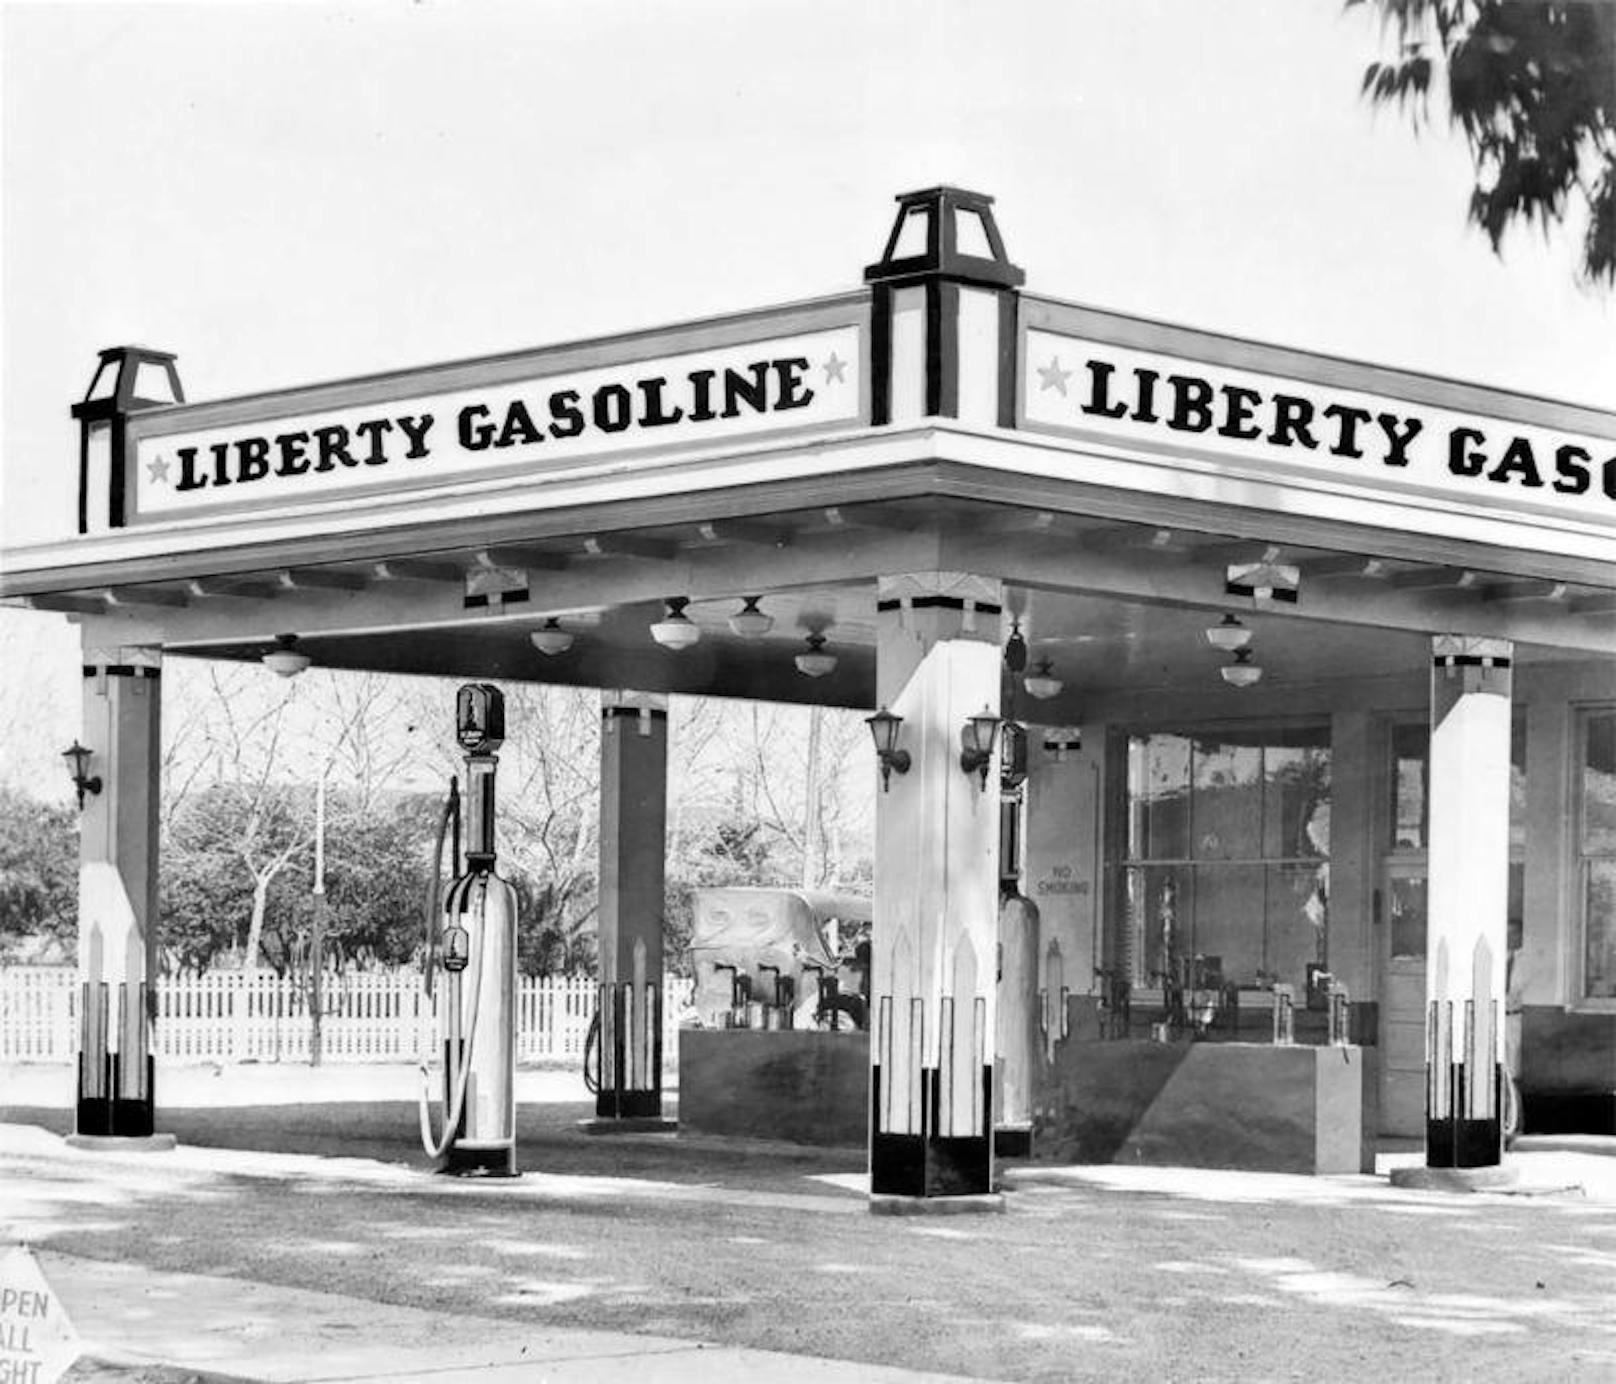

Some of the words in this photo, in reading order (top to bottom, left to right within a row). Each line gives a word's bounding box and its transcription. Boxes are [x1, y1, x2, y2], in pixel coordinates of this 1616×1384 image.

[175, 414, 435, 492] LIBERTY
[458, 357, 815, 451] GASOLINE
[1081, 360, 1423, 468] LIBERTY
[1052, 866, 1072, 878] NO
